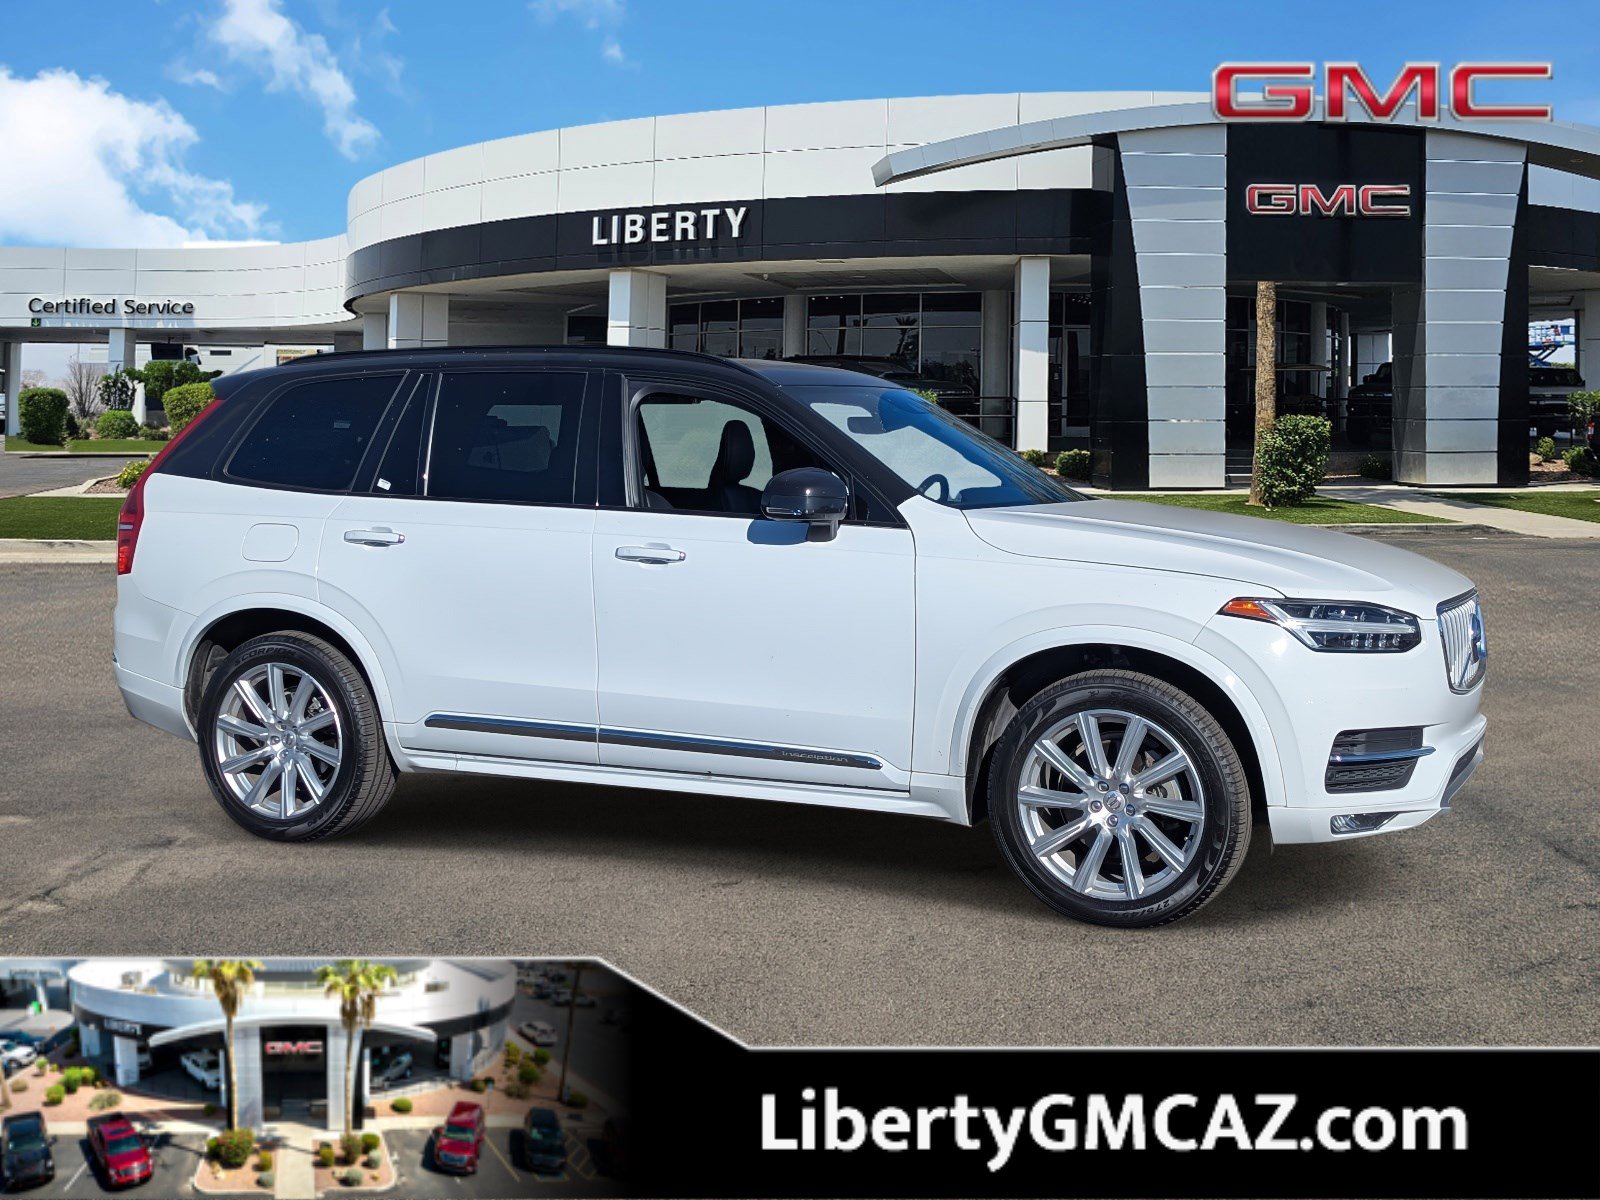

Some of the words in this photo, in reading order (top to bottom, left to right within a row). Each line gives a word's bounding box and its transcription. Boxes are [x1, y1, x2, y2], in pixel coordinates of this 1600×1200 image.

[1246, 184, 1411, 217] GMC
[592, 207, 748, 246] LIBERTY
[28, 297, 116, 315] Certified
[123, 299, 194, 315] Service
[781, 751, 849, 763] Inscription
